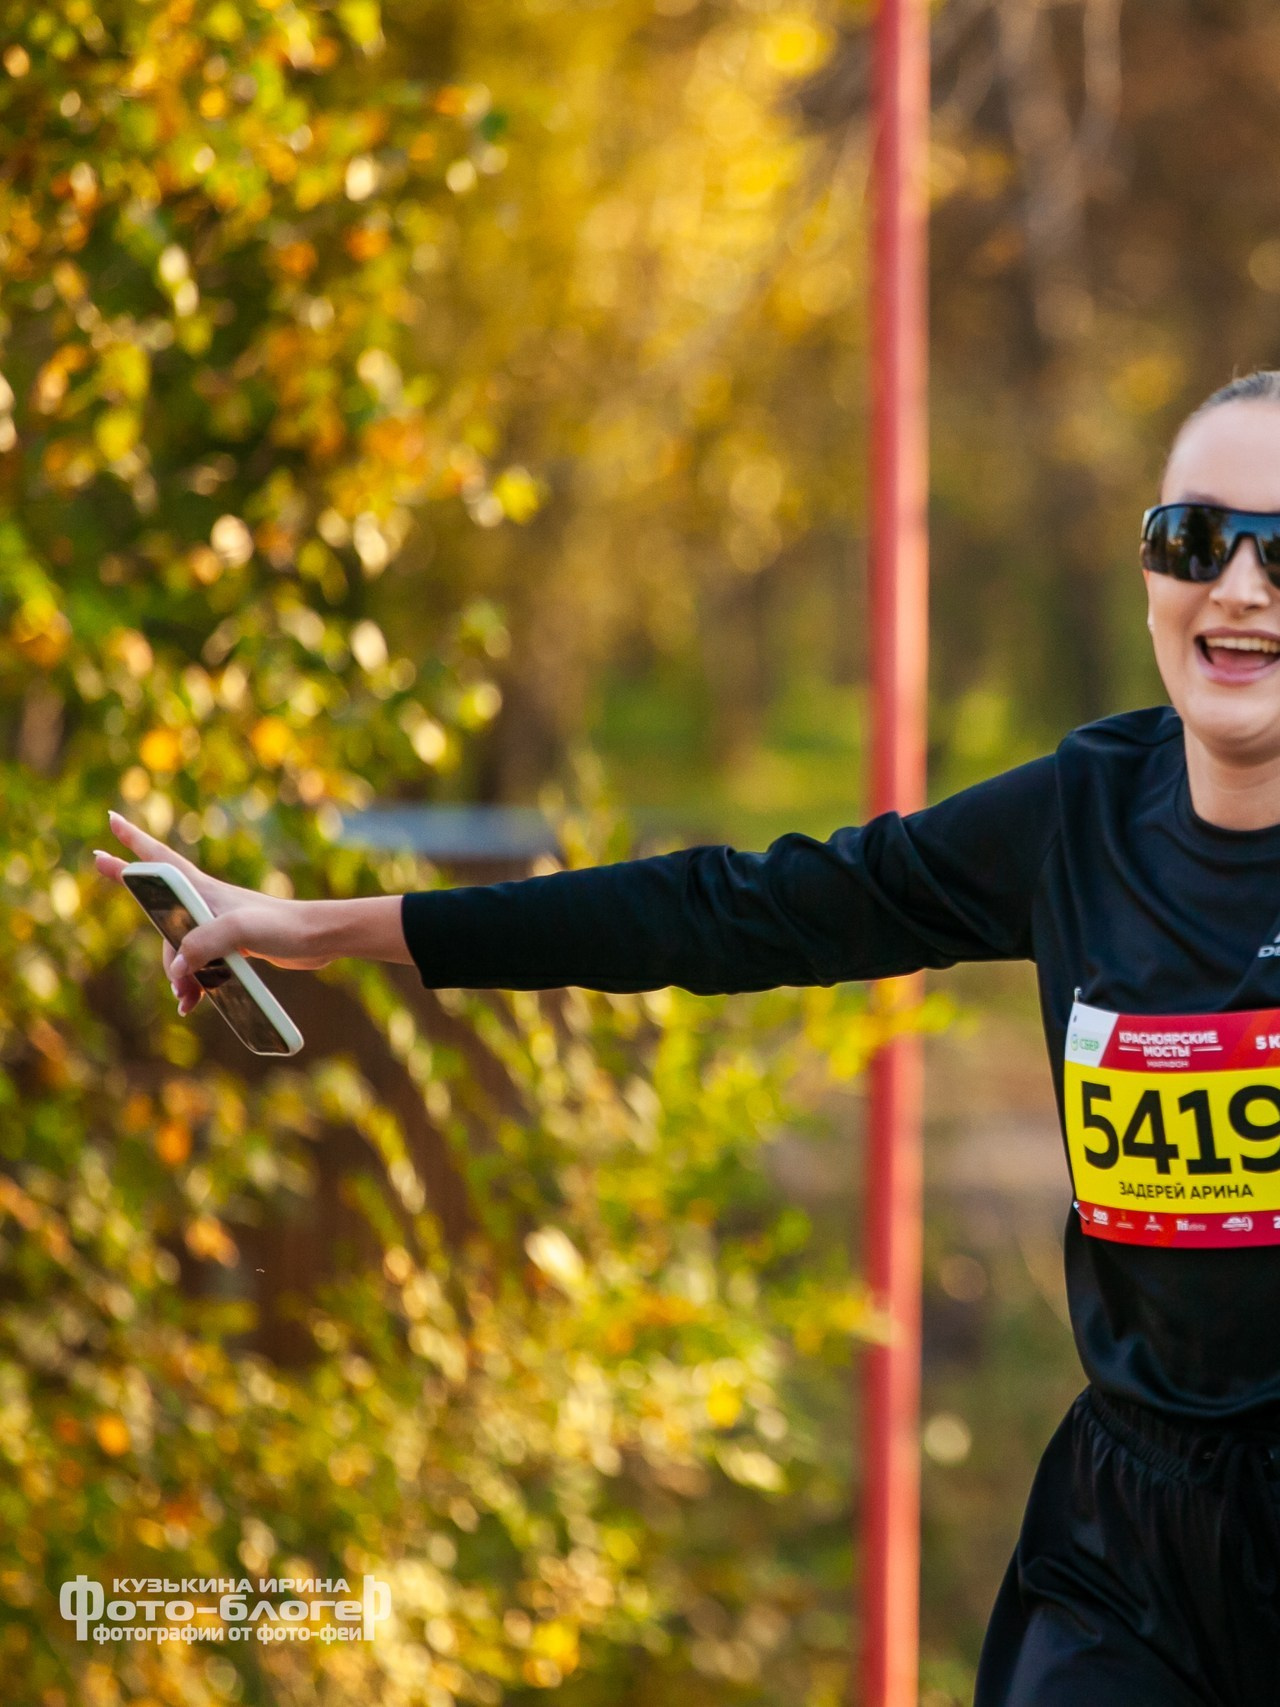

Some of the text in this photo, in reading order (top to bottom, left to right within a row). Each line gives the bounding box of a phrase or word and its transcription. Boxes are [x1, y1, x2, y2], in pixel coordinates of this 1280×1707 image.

[1118, 1030, 1219, 1046] КРАСНОЯРСКИЕ
[1255, 1036, 1267, 1050] 5
[1142, 1045, 1191, 1058] МОСТЫ
[1119, 1181, 1254, 1200] ЗАДЕРЕЙ АРИНА
